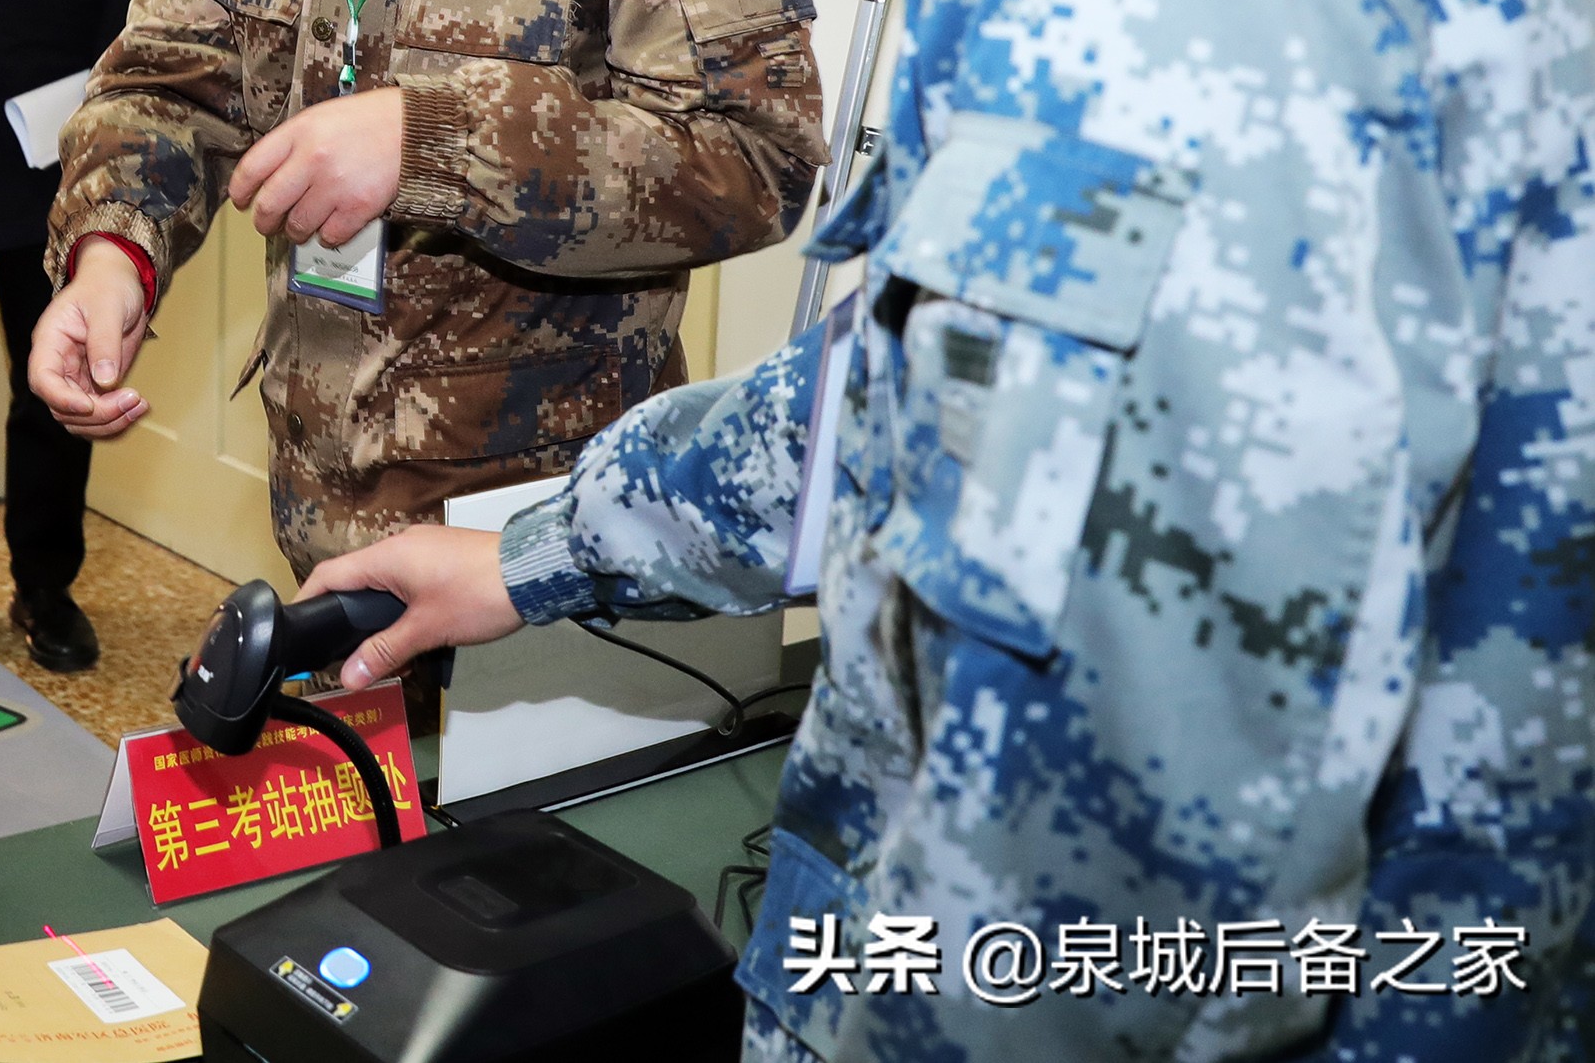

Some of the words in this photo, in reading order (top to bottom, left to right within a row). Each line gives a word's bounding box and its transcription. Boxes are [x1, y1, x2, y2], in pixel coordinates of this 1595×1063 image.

[148, 752, 413, 871] 第三考站抽题处
